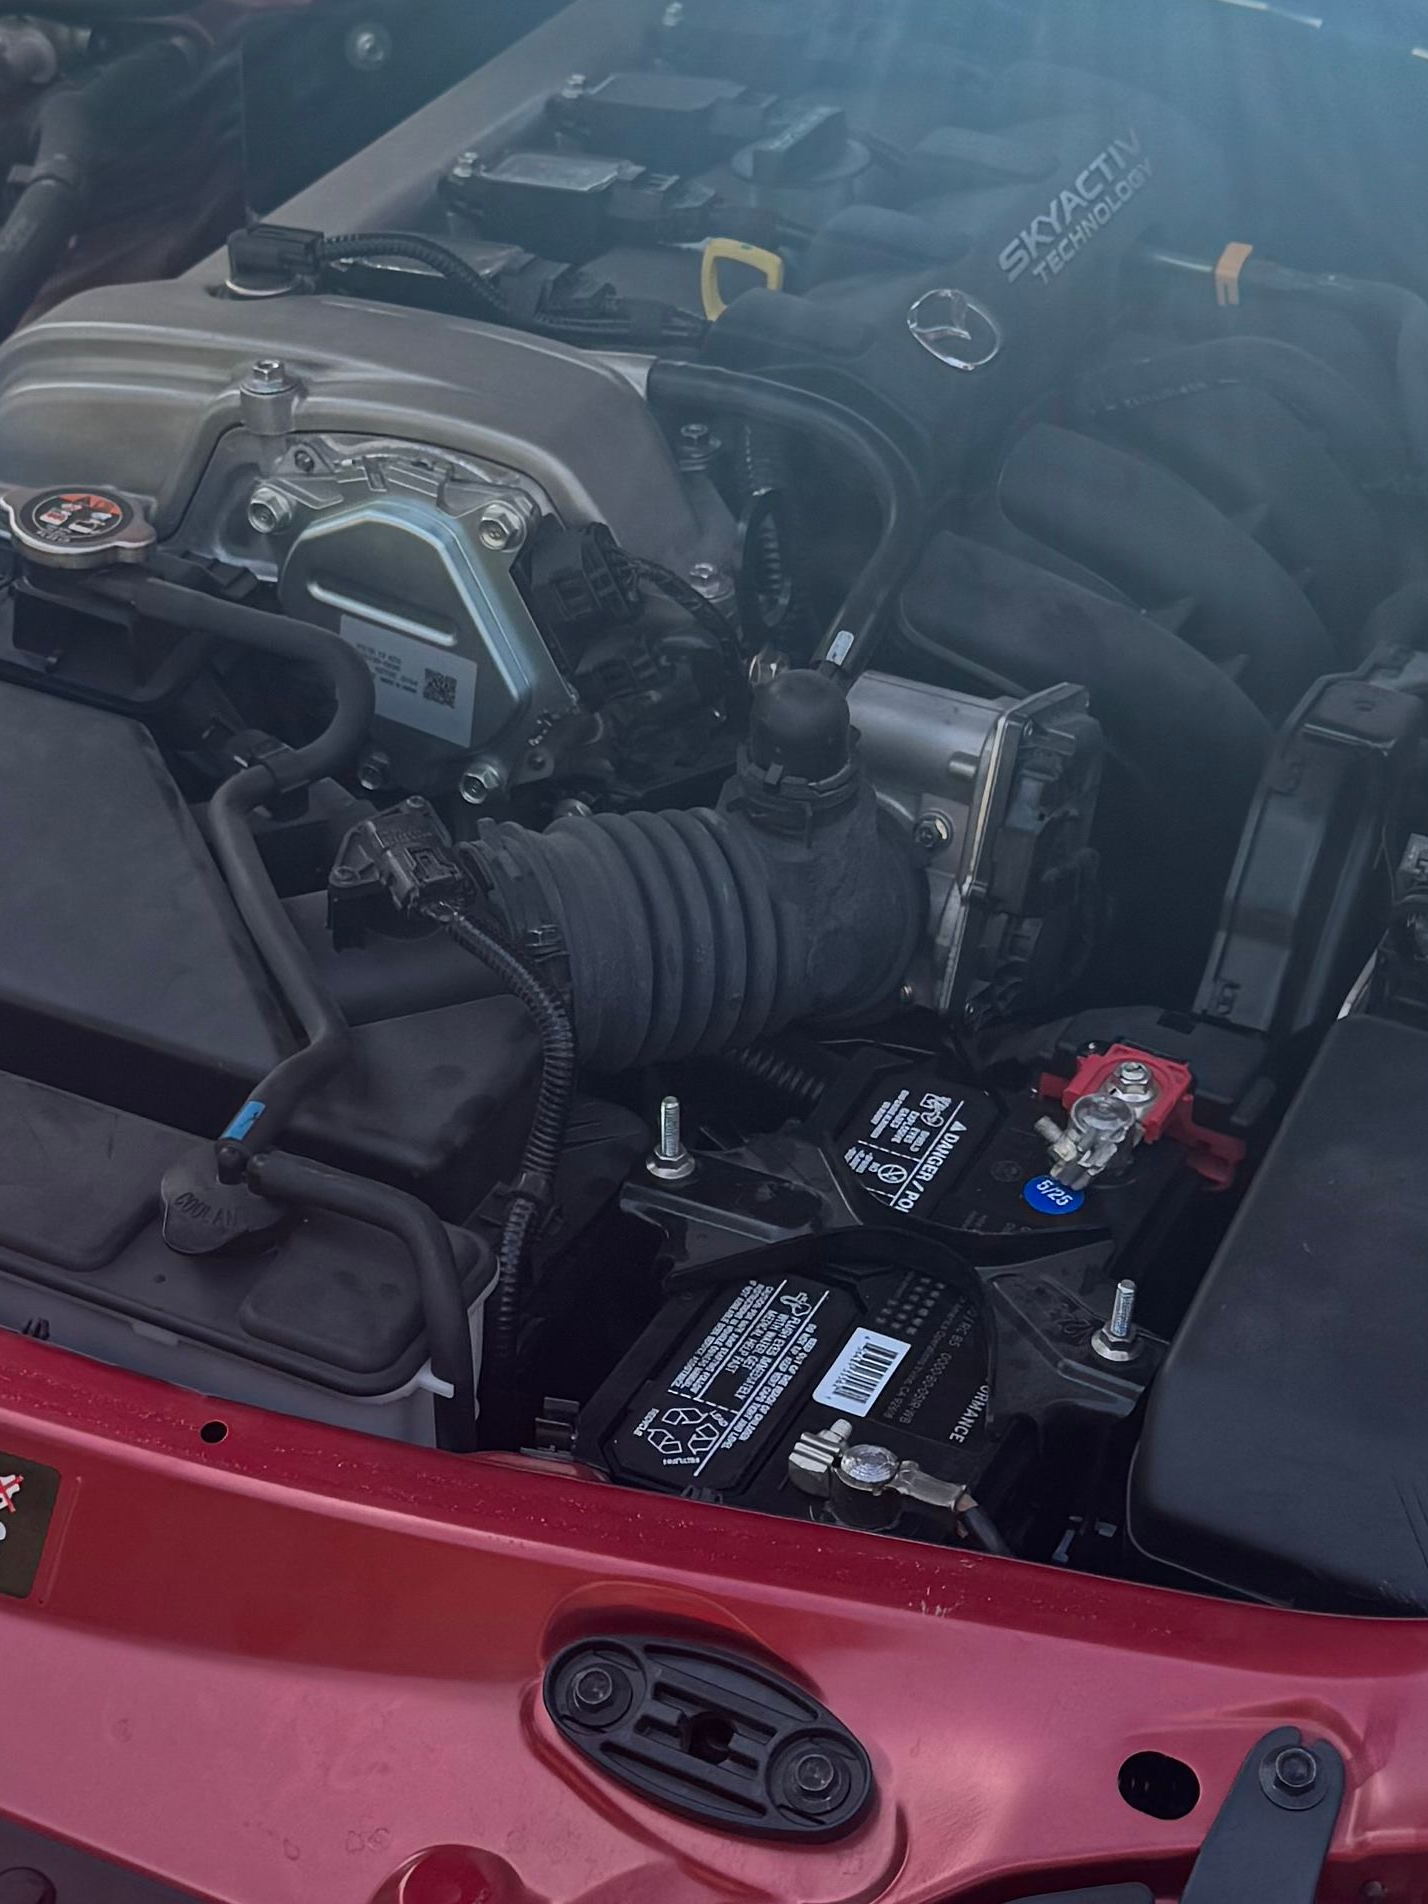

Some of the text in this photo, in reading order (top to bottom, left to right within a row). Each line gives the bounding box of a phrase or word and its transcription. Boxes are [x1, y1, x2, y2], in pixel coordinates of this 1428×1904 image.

[999, 127, 1140, 283] SKYACTIV
[1033, 158, 1152, 284] TECHNOLOGY
[919, 1132, 960, 1182] DANGER
[725, 1356, 744, 1373] FAST
